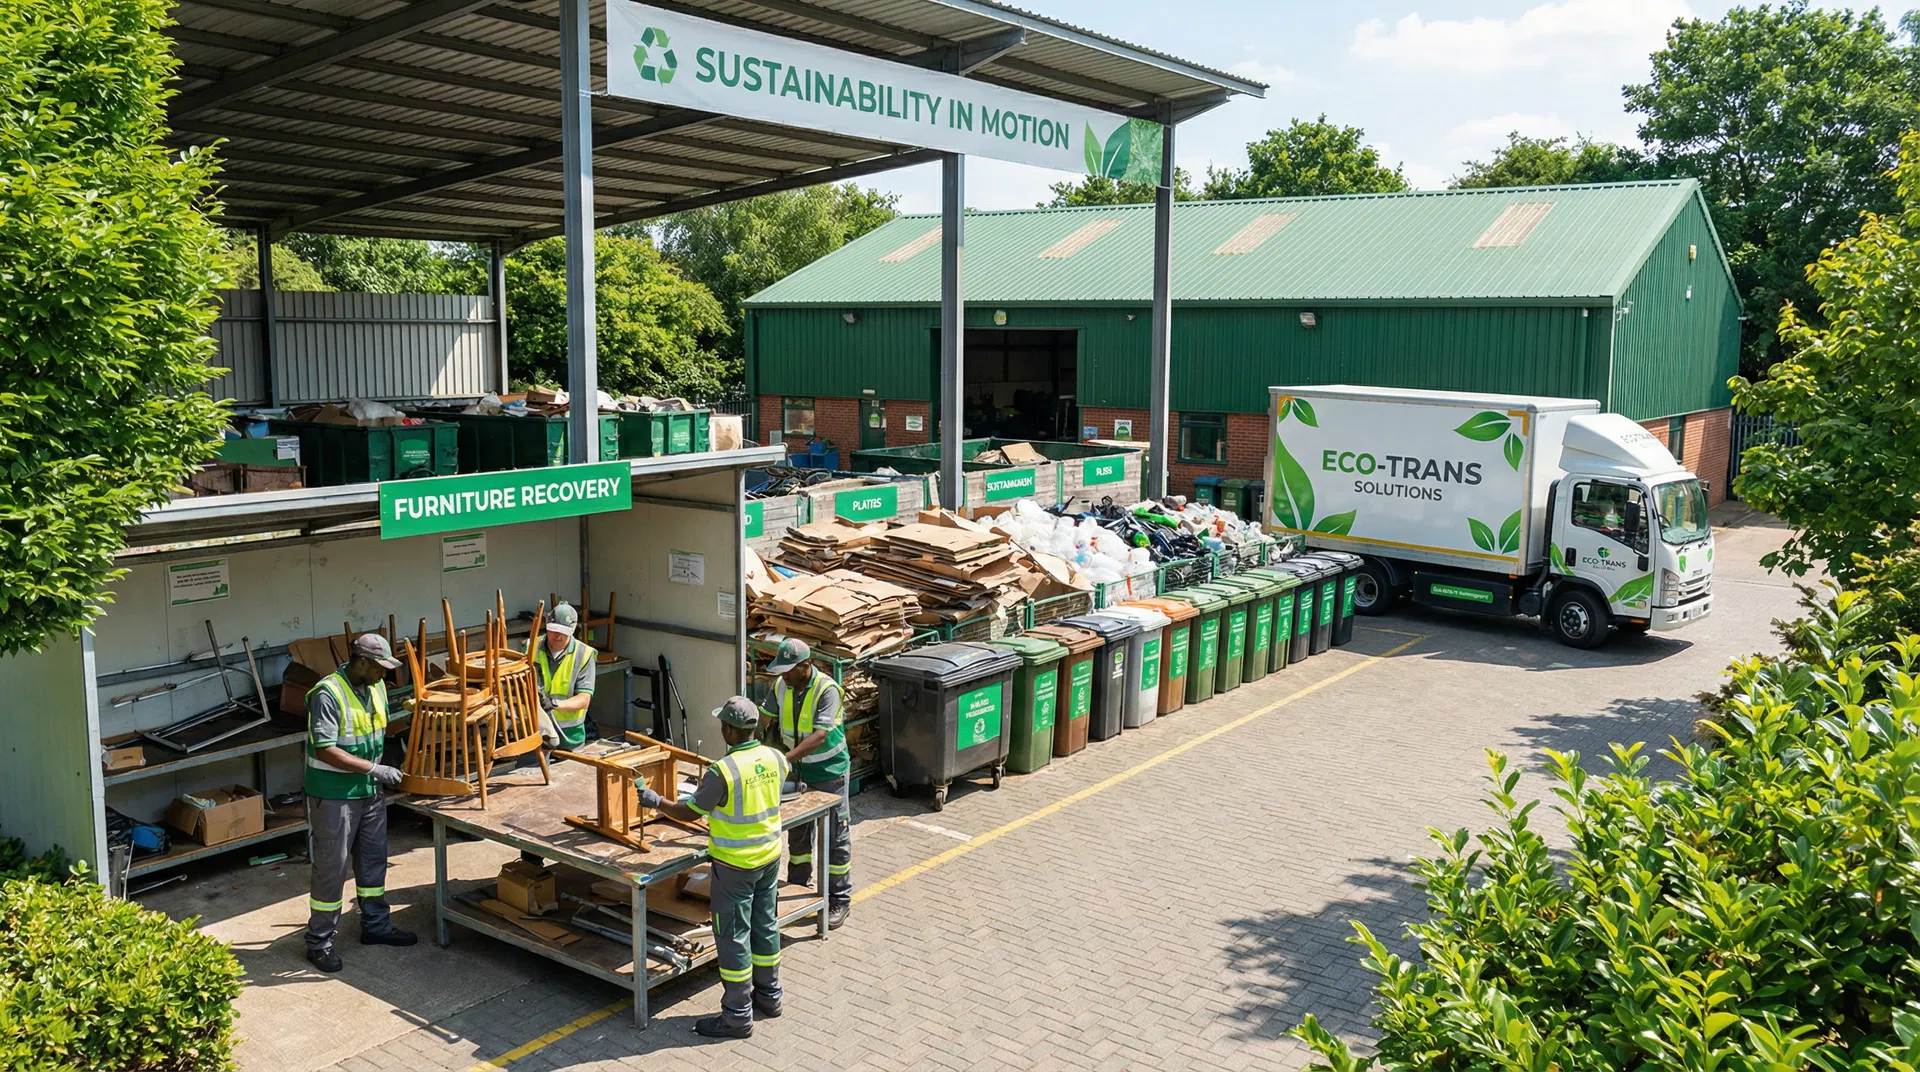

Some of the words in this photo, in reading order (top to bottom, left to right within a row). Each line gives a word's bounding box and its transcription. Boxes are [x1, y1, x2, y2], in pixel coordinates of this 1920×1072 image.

[695, 47, 942, 124] SUSTAINABILITY
[949, 100, 973, 130] IN
[981, 107, 1069, 149] MOTION
[1322, 449, 1483, 486] ECO-TRANS
[394, 487, 516, 521] FURNITURE
[521, 477, 621, 506] RECOVERY
[1354, 480, 1443, 502] SOLUTIONS
